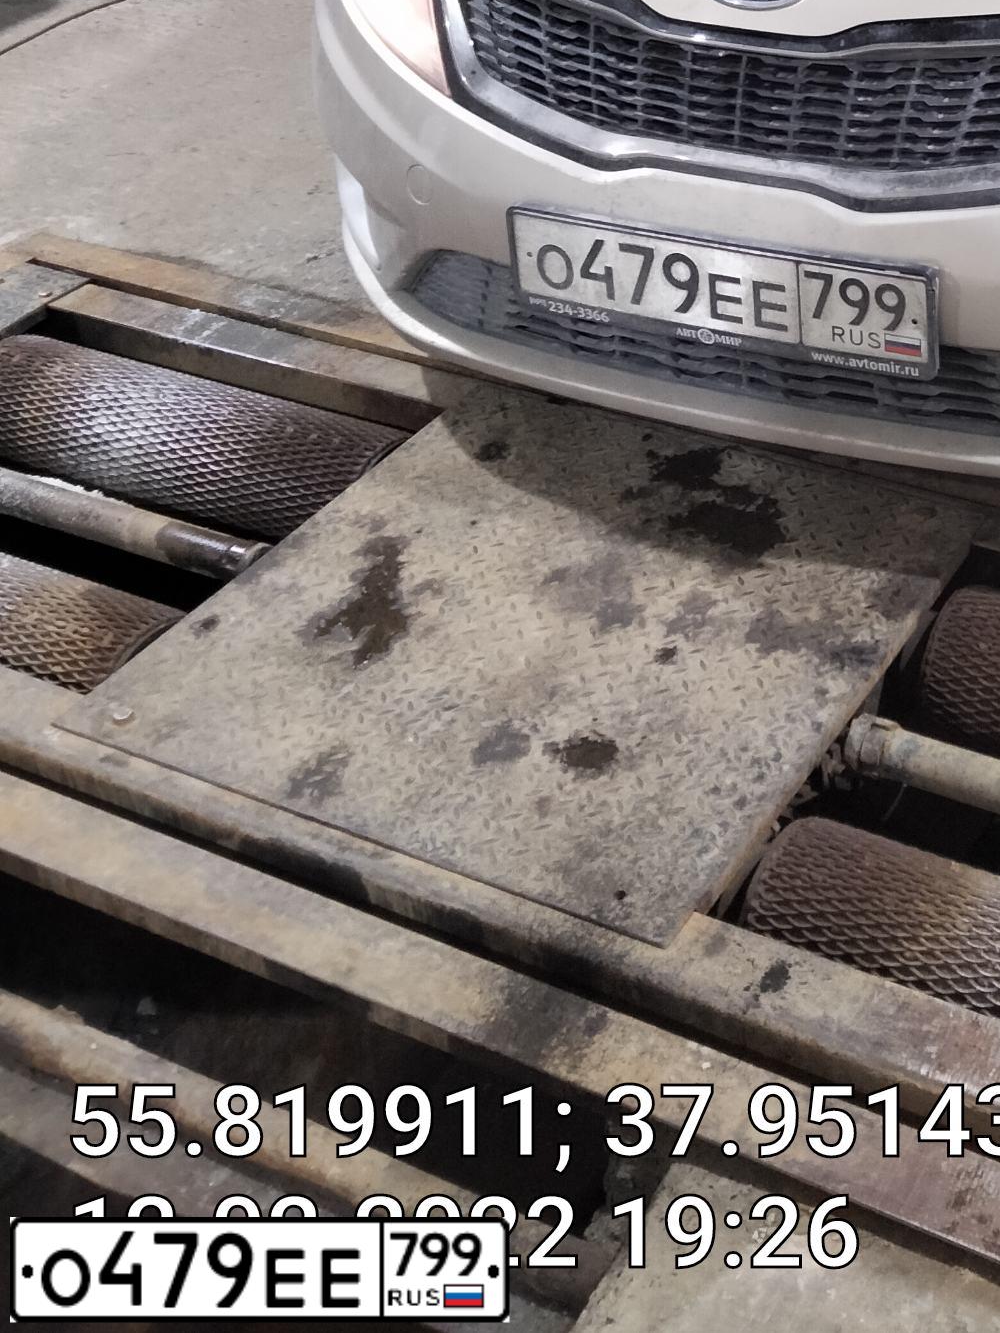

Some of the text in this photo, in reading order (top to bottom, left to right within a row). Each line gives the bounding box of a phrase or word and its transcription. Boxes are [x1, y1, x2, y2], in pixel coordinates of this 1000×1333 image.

[548, 301, 610, 323] 234-3366
[803, 271, 907, 332] 799
[831, 325, 881, 349] RUS
[811, 352, 920, 377] www.avtomir.ru
